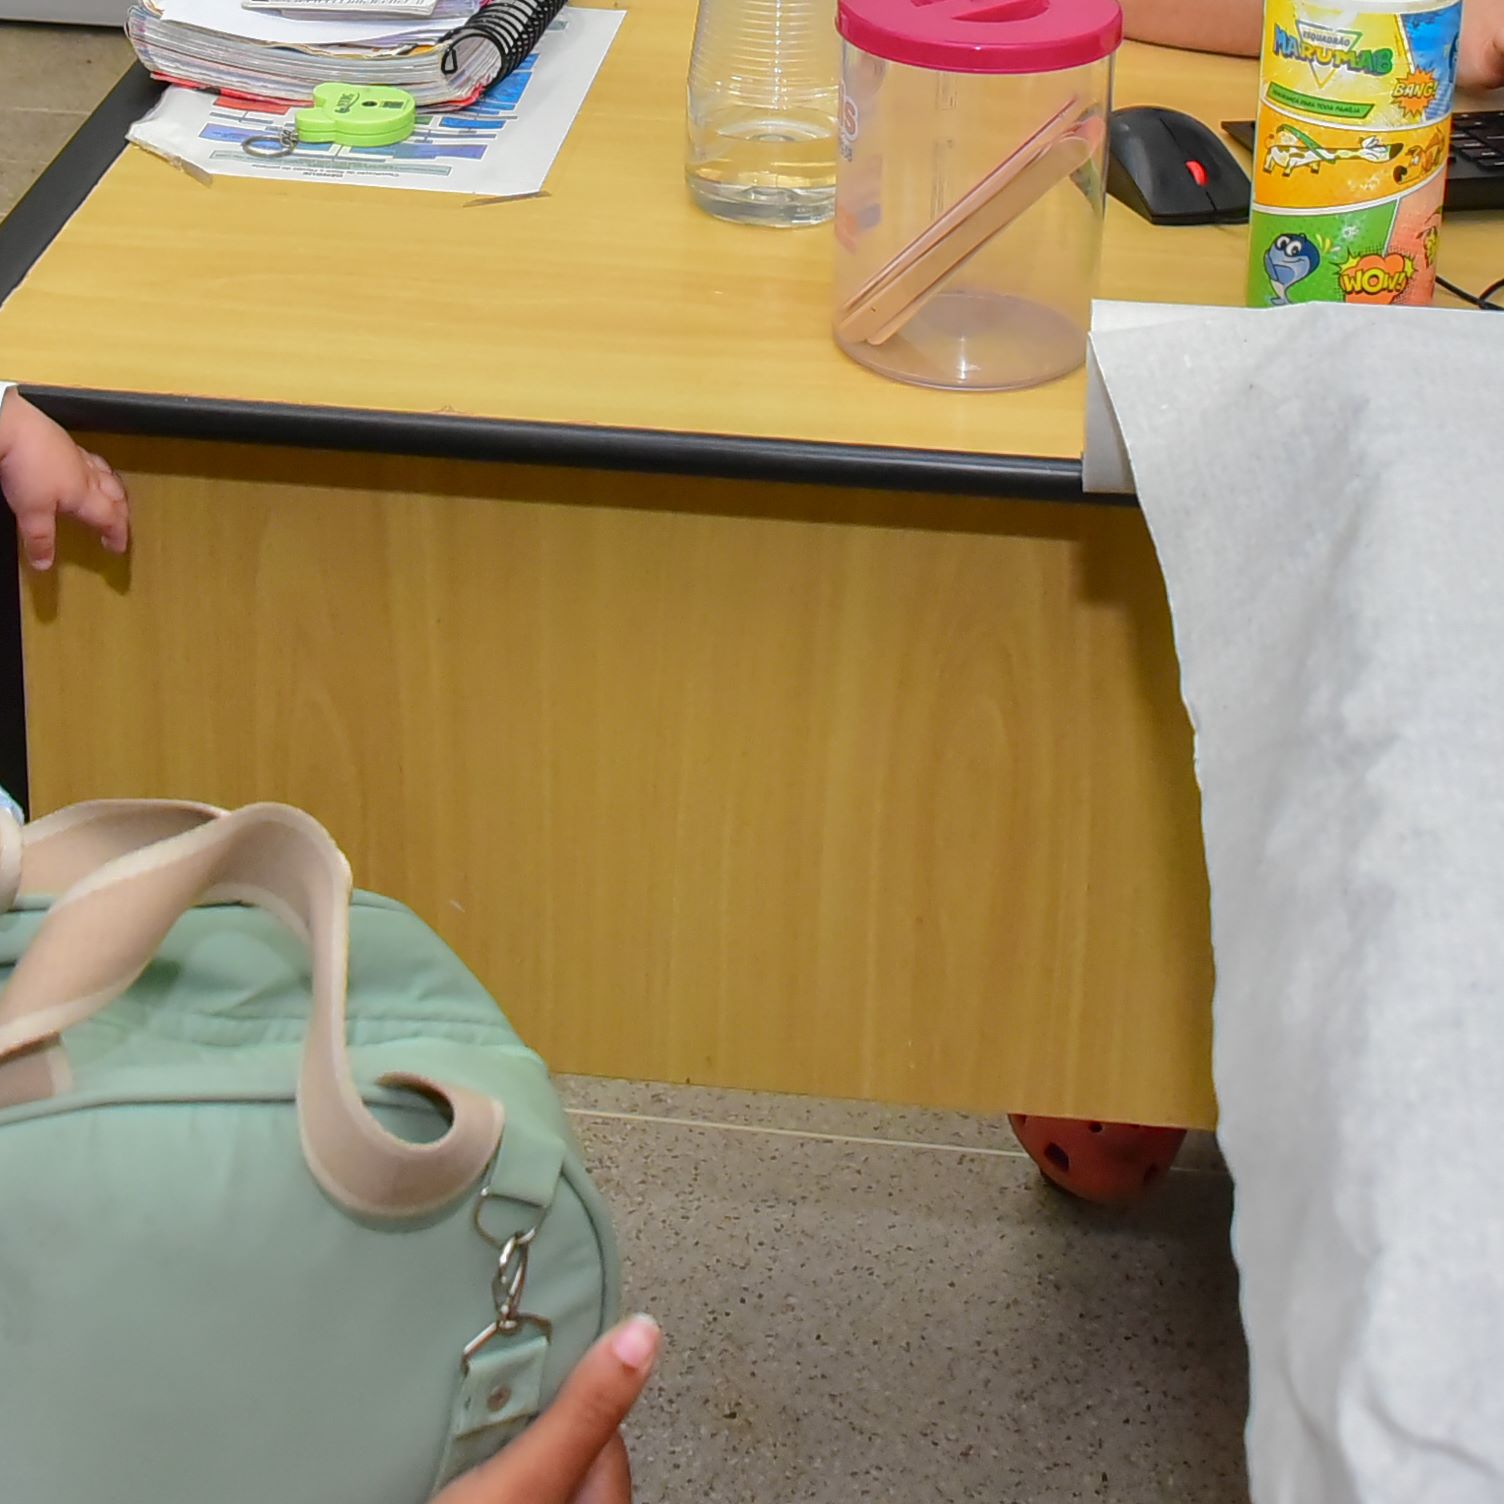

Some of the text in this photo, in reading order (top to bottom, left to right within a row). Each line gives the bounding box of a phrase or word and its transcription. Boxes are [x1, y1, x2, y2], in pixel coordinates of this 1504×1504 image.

[1272, 22, 1394, 77] MARUMAB
[1302, 30, 1351, 48] ESQUADRÃO
[1393, 80, 1439, 98] BANG!
[1341, 267, 1407, 295] WOW!
